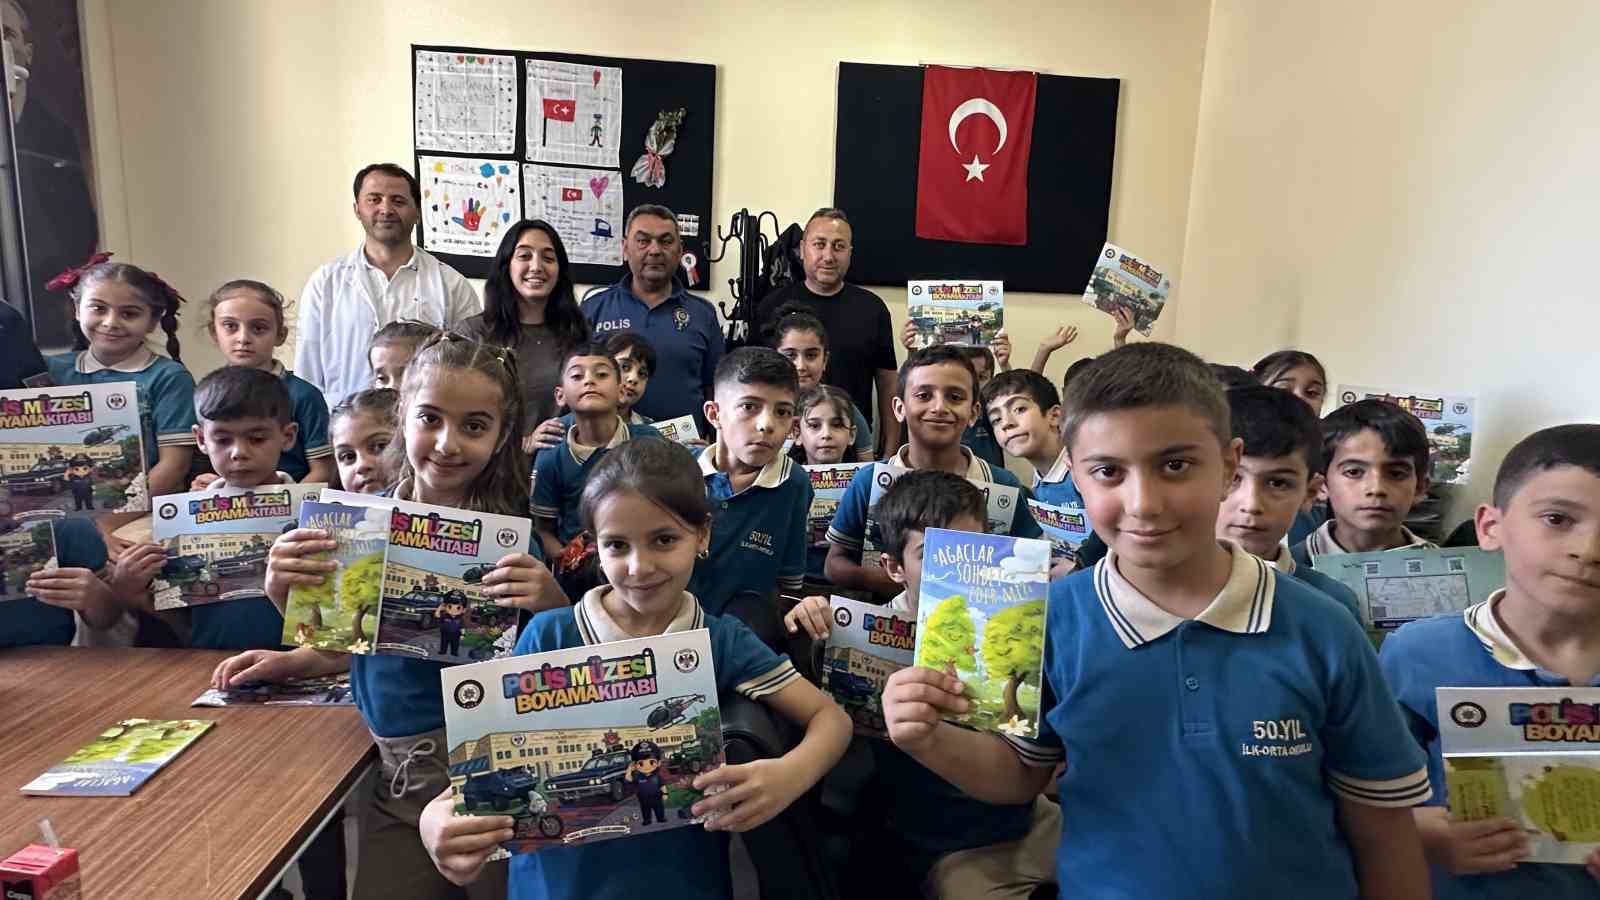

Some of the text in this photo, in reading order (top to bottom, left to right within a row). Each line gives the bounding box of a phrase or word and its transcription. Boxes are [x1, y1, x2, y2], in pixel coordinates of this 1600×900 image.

[22, 391, 91, 415] MÜZESİ
[189, 489, 291, 515] POLİS MÜZESİ
[410, 512, 481, 542] MÜZESİ
[863, 613, 908, 637] POLİS
[503, 648, 657, 698] POLİS MÜZESİ
[1509, 698, 1594, 726] POLİS
[1252, 719, 1306, 741] 50.YIL
